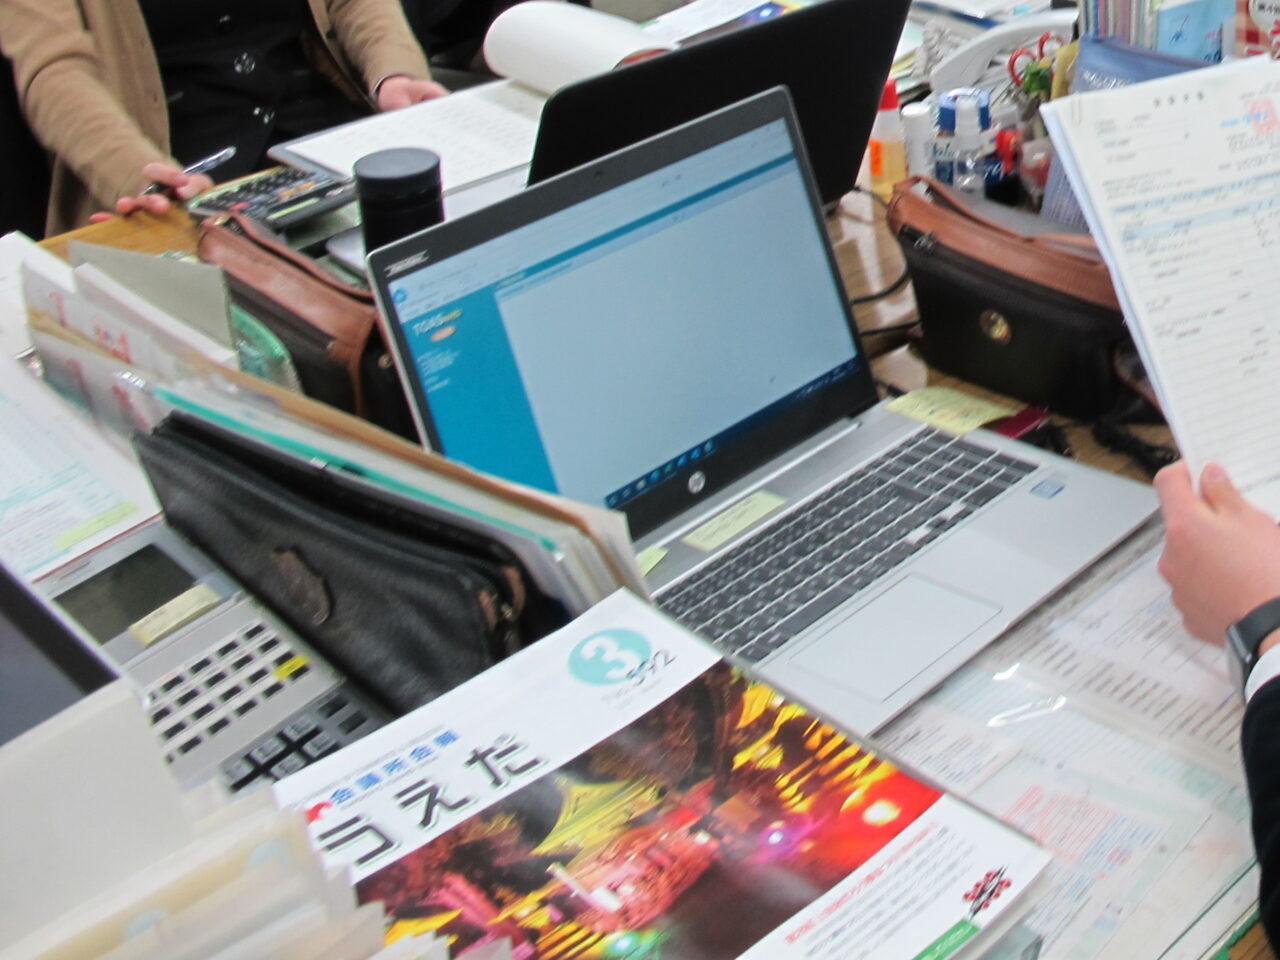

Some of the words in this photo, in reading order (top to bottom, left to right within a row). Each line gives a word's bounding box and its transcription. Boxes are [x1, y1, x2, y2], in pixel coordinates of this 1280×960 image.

[580, 636, 641, 679] 3
[317, 733, 543, 867] うえだ
